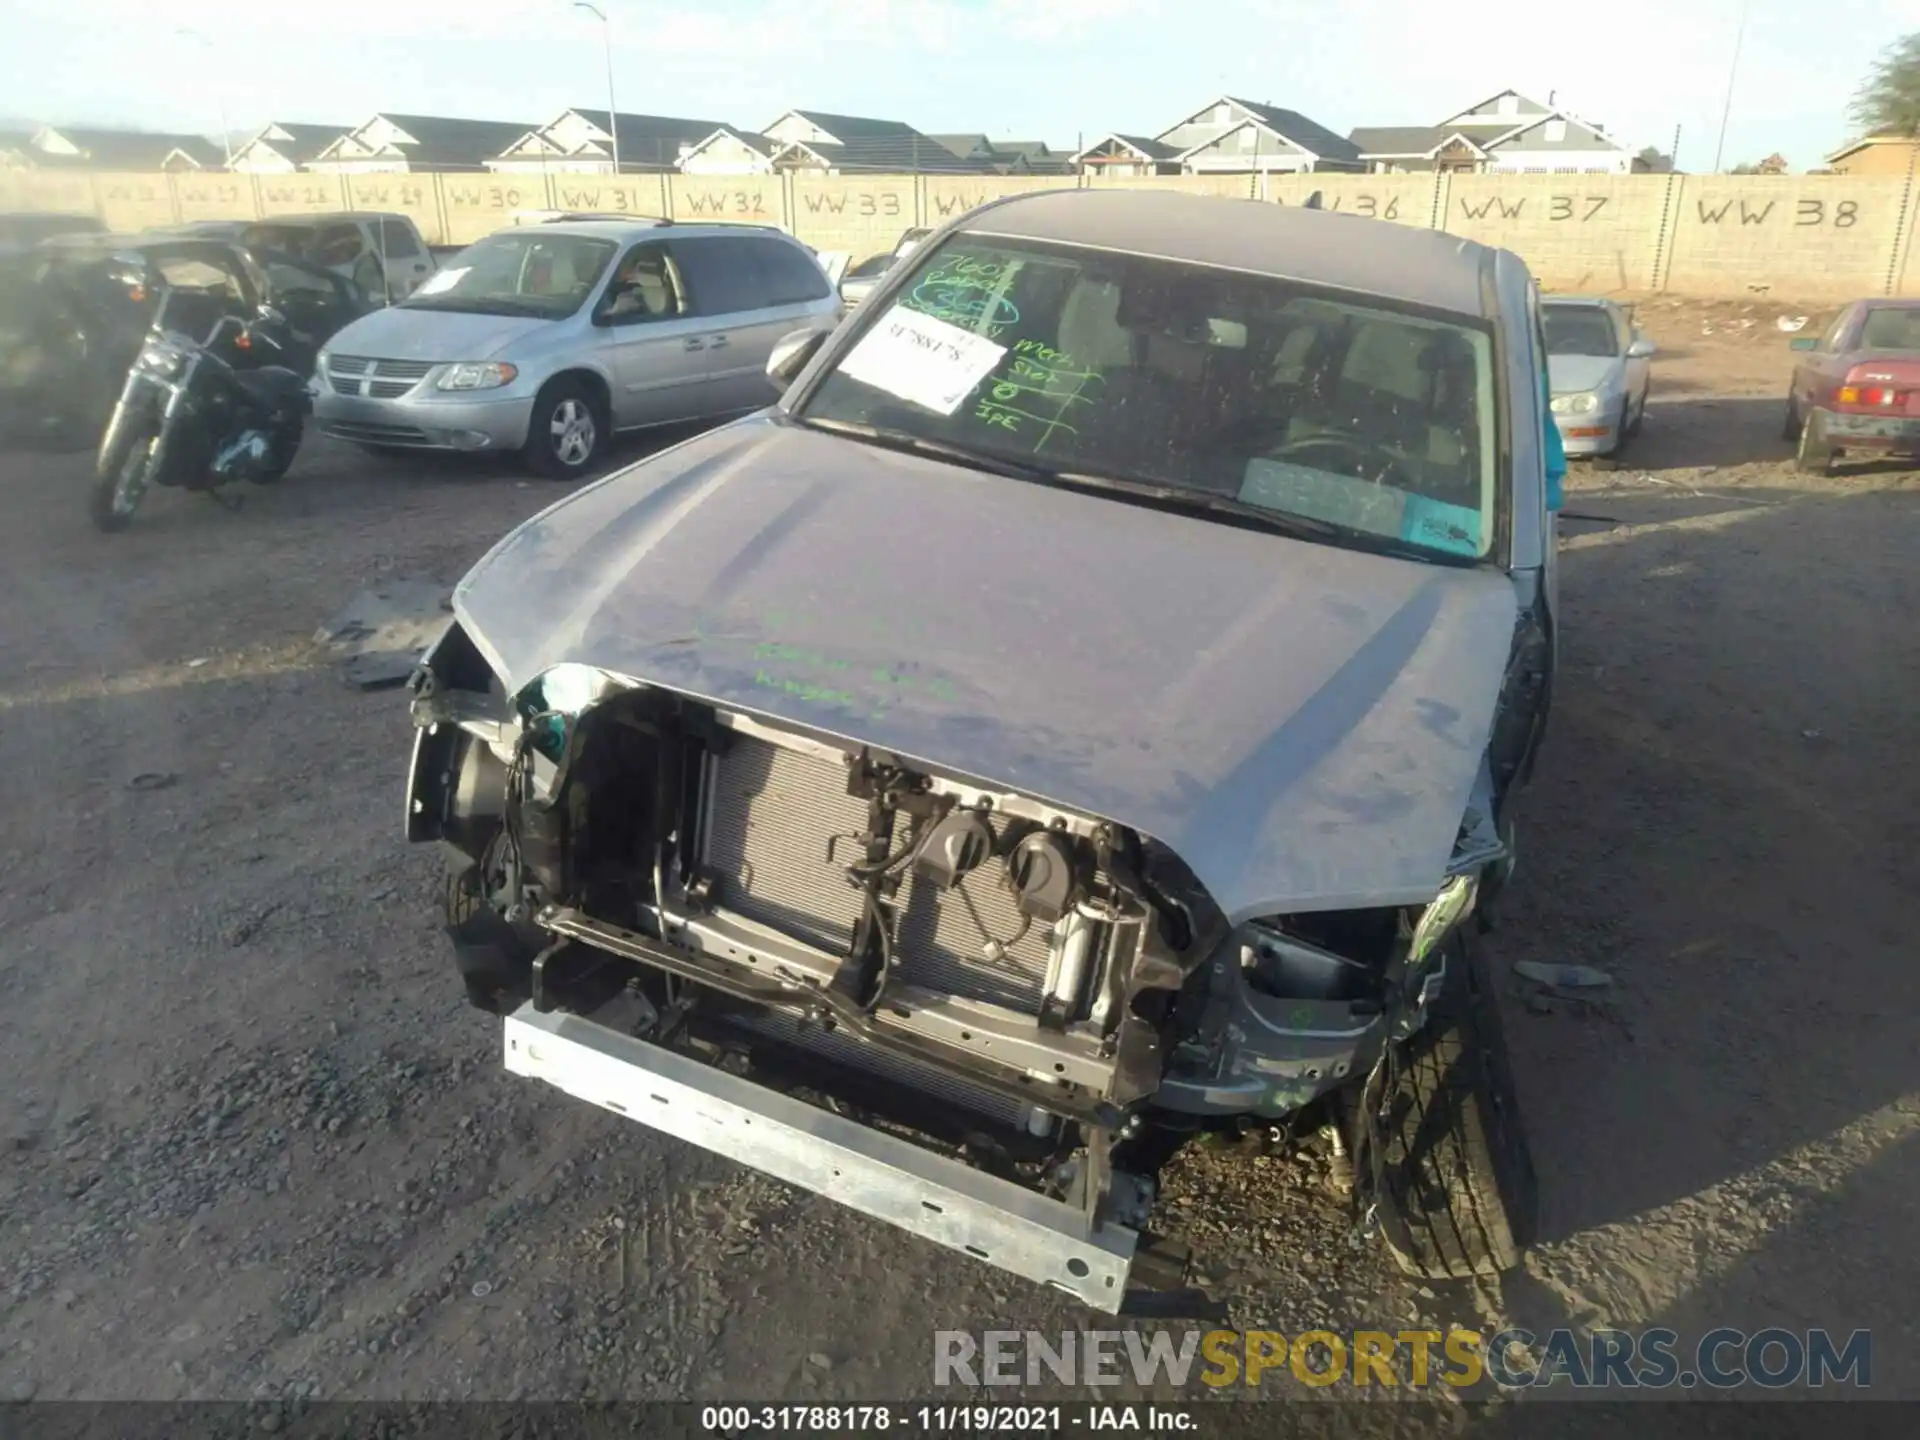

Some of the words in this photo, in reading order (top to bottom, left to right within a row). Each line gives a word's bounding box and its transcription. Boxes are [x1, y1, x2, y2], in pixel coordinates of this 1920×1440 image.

[488, 189, 520, 207] 30
[563, 189, 600, 208] WW
[613, 190, 637, 209] 31
[687, 192, 728, 213] WW
[735, 193, 766, 213] 32
[804, 193, 847, 215] WW
[859, 193, 900, 215] 33
[1357, 195, 1399, 219] 36
[1461, 197, 1526, 219] WW
[1549, 197, 1608, 221] 37
[1697, 200, 1775, 225] WW
[1795, 200, 1859, 228] 38
